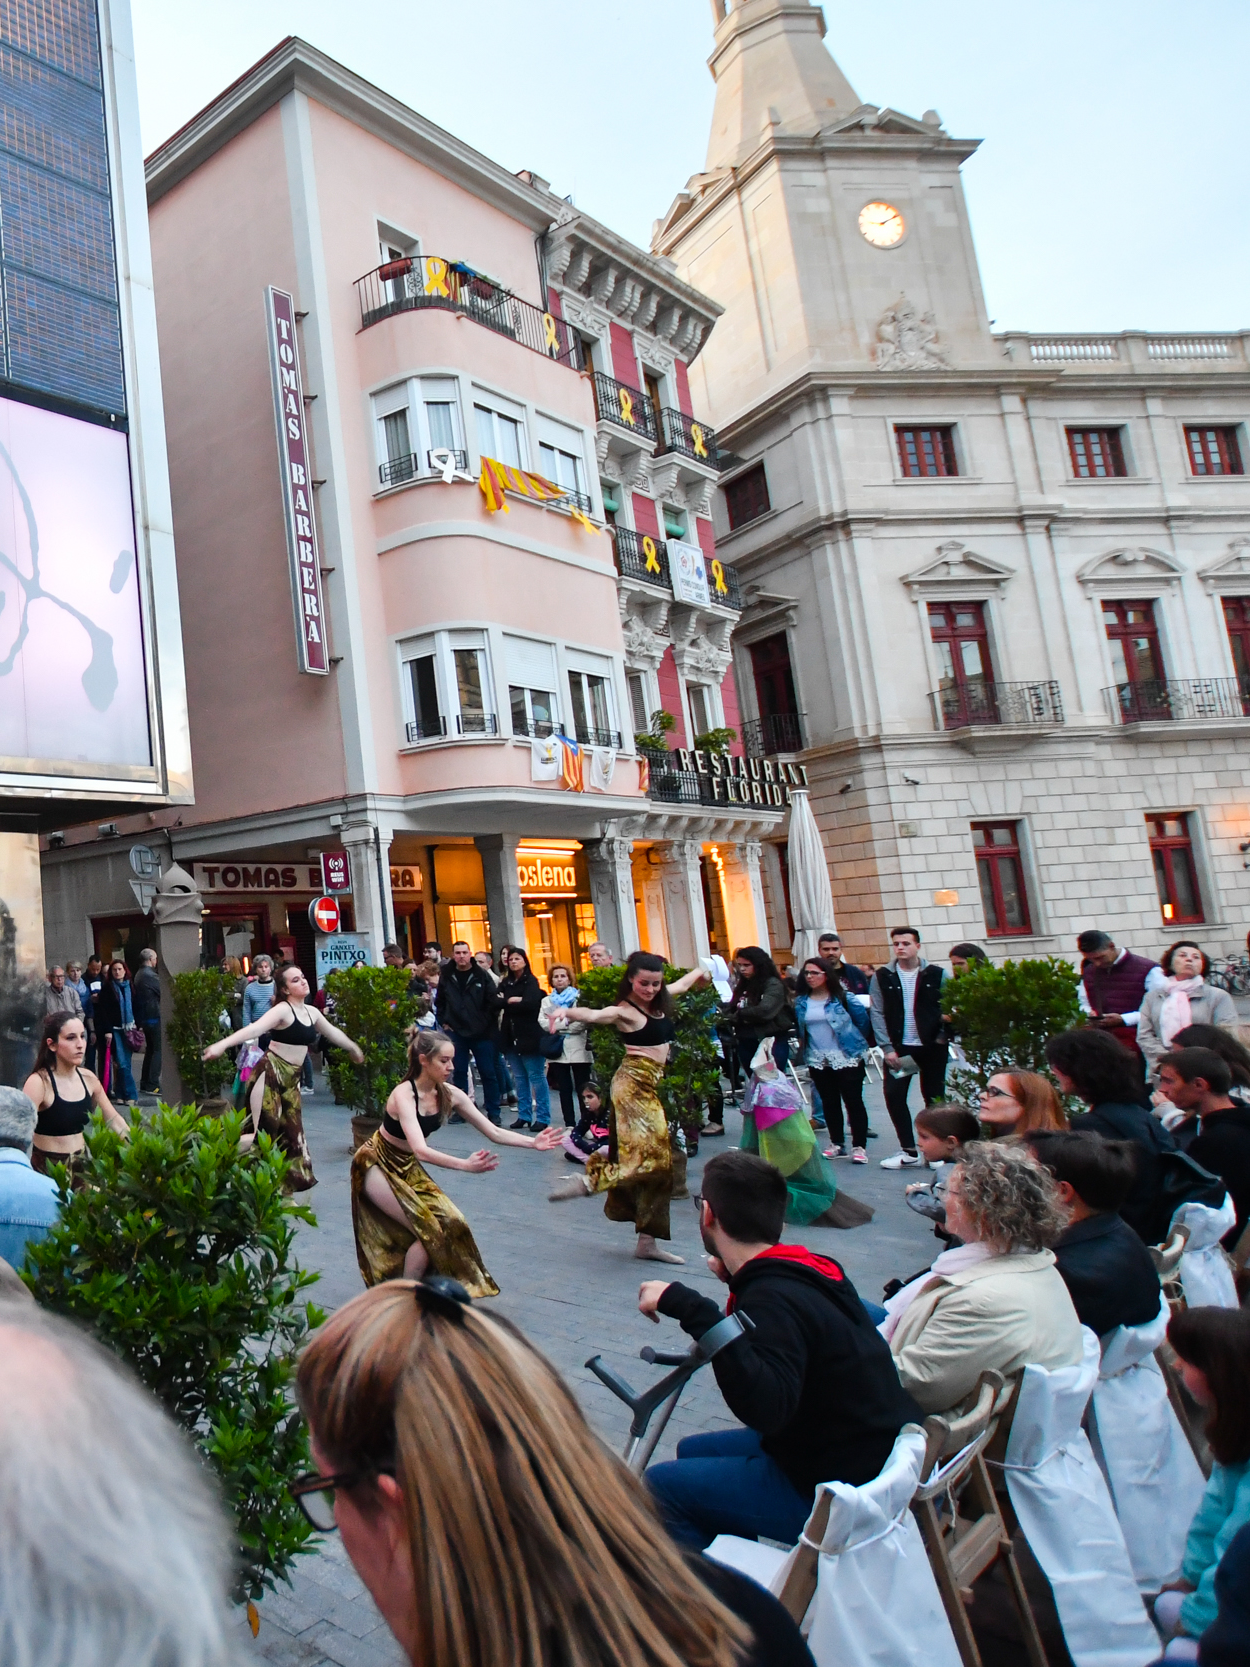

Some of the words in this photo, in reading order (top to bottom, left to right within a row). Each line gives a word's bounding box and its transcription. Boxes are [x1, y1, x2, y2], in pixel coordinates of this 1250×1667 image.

[677, 748, 809, 786] RESTAURANT
[711, 776, 794, 807] FLORIDA
[203, 866, 298, 888] TOMAS
[517, 858, 577, 887] oslena
[321, 950, 366, 961] PINTXO
